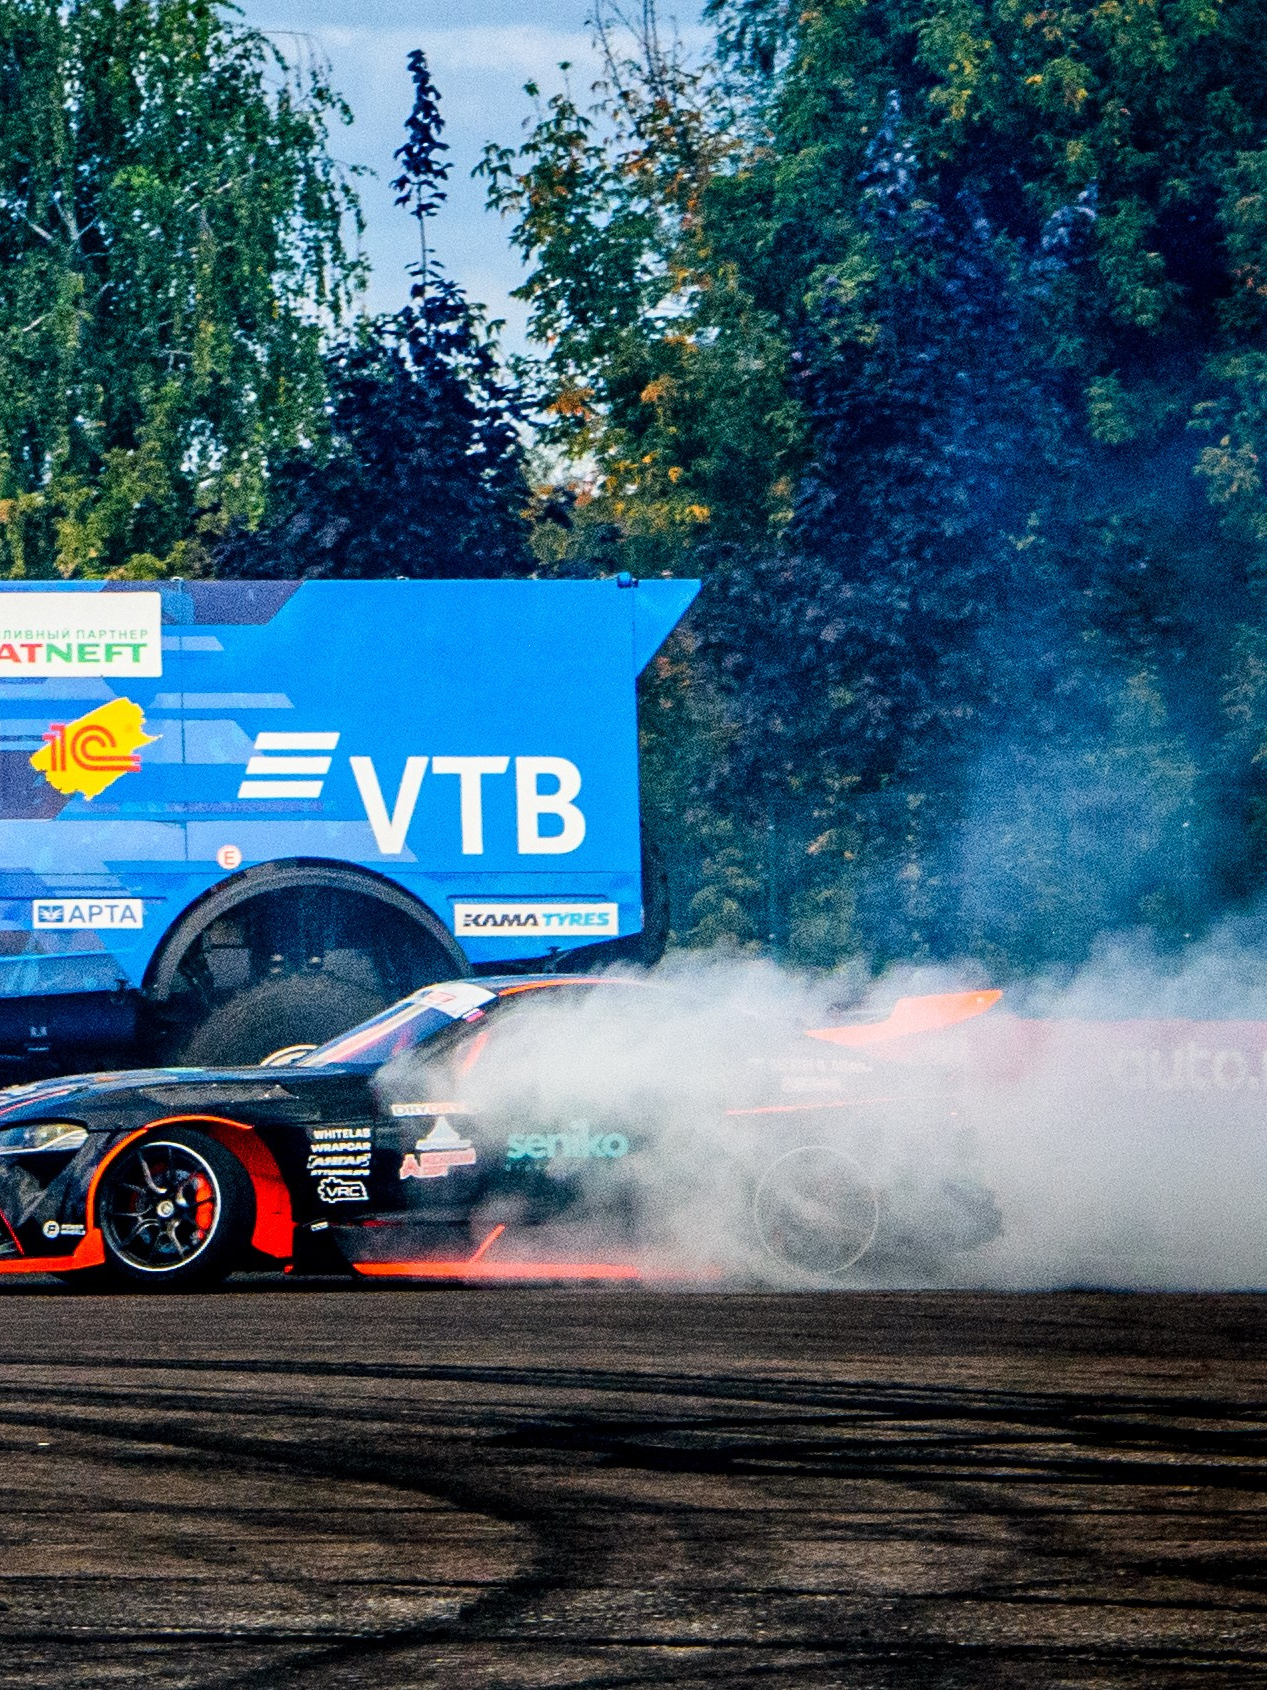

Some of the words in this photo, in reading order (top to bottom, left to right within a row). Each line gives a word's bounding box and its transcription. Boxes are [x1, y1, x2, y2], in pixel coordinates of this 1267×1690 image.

[75, 627, 150, 640] ПАРТНЕР
[349, 756, 587, 855] VTB
[463, 913, 539, 927] KAMA
[542, 912, 610, 927] TYRES
[1111, 1040, 1267, 1091] auto.
[313, 1128, 371, 1139] WHITELAB
[506, 1118, 630, 1159] seniko
[311, 1142, 371, 1153] WRAPCAR
[326, 1186, 360, 1196] VRC
